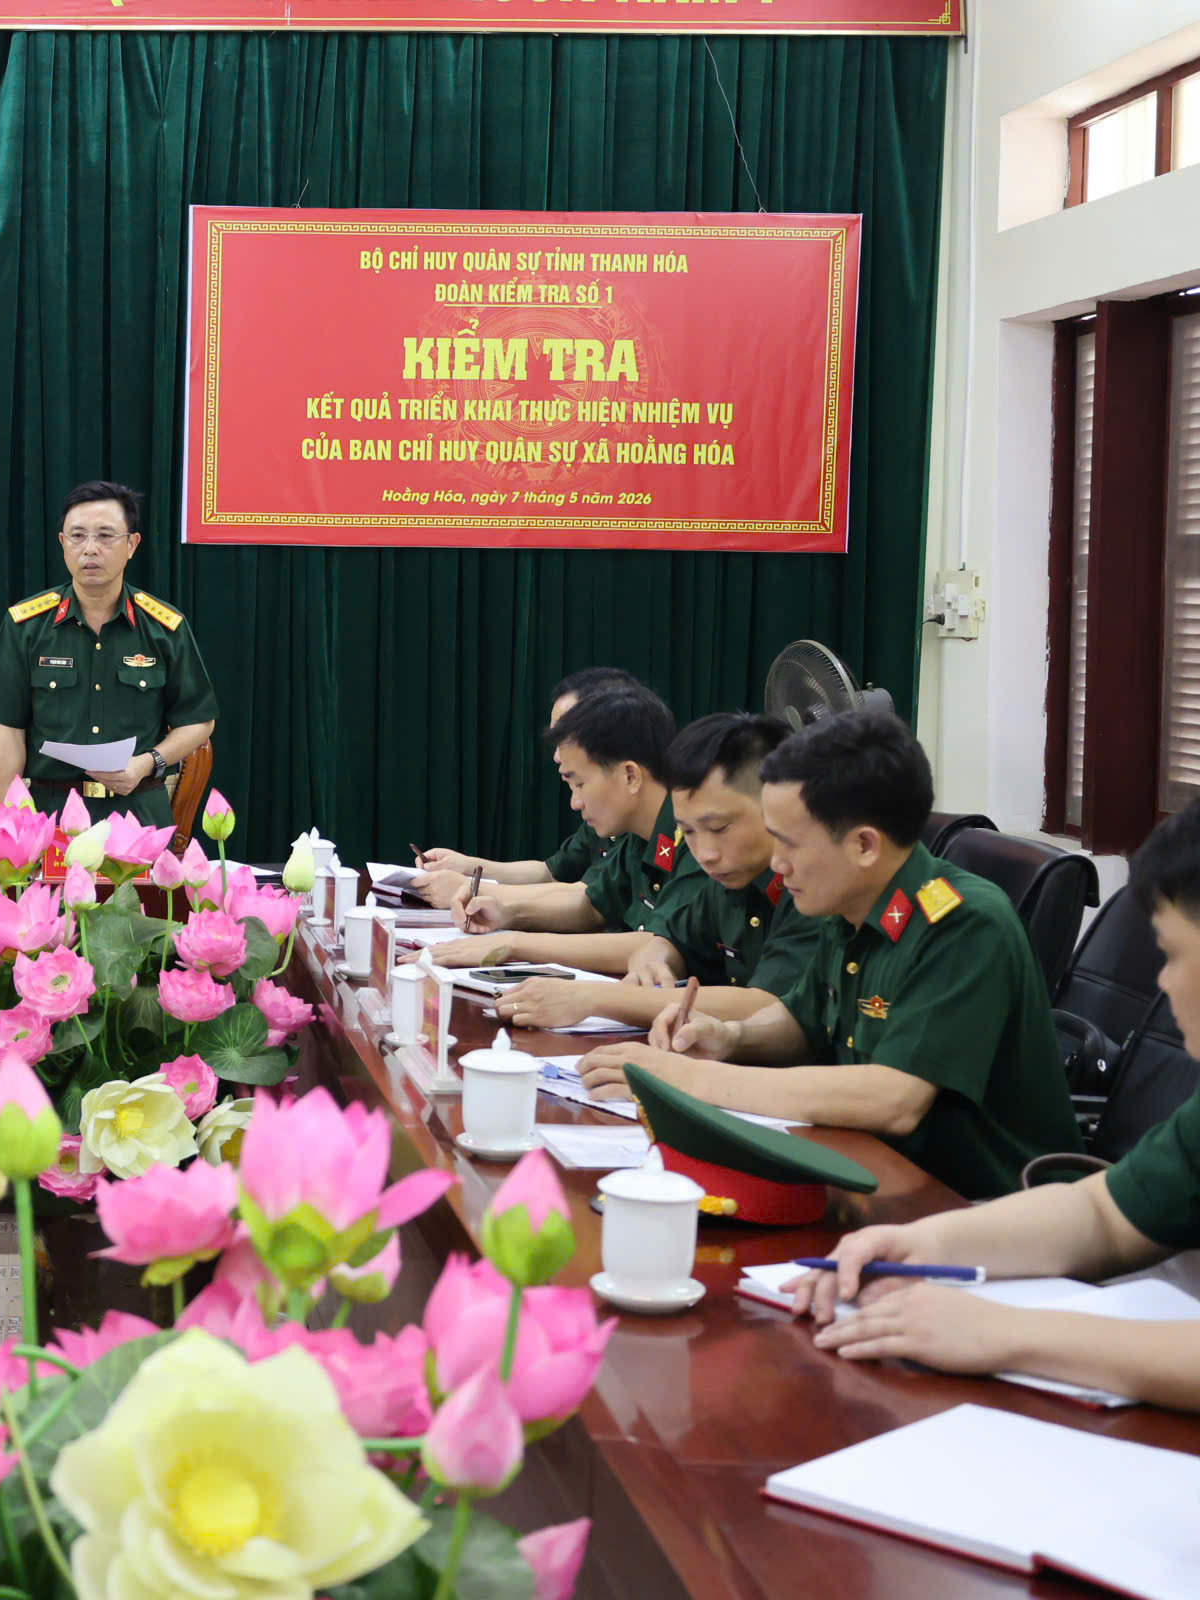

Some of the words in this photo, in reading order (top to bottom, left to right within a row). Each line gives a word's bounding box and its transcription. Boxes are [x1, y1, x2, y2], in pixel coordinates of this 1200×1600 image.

[360, 247, 384, 273] BỘ
[389, 244, 419, 270] CHỈ
[423, 252, 457, 270] HUY
[463, 248, 511, 272] QUÂN
[516, 251, 543, 275] SỰ
[545, 246, 585, 272] TỈNH
[590, 253, 648, 273] THANH
[653, 252, 689, 273] HÓA
[435, 280, 483, 303] ĐOÀN
[488, 276, 533, 303] KIỂM
[539, 283, 571, 304] TRA
[575, 278, 601, 304] SỐ
[605, 285, 614, 304] 1
[402, 318, 529, 380] KIỂM
[543, 338, 640, 382] TRA
[306, 395, 345, 420] KẾT
[350, 393, 392, 421] QUẢ
[398, 391, 457, 421] TRIỂN
[463, 399, 512, 422] KHAI
[518, 399, 571, 426] THỰC
[578, 400, 626, 427] HIỆN
[632, 398, 701, 429] NHIỆM
[706, 402, 734, 430] VỤ
[301, 432, 343, 461] CỦA
[349, 439, 392, 461] BAN
[398, 435, 433, 462] CHỈ
[439, 441, 480, 463] HUY
[485, 437, 543, 464] QUÂN
[548, 439, 579, 468] SỰ
[582, 438, 610, 464] XÃ
[616, 435, 687, 465] HOẰNG
[693, 440, 736, 465] HÓA
[382, 487, 431, 507] Hoằng
[434, 488, 467, 506] Hóa,
[470, 490, 508, 508] ngày
[511, 491, 521, 504] 7
[524, 489, 567, 508] tháng
[569, 491, 579, 505] 5
[581, 490, 615, 505] năm
[617, 492, 653, 505] 2026
